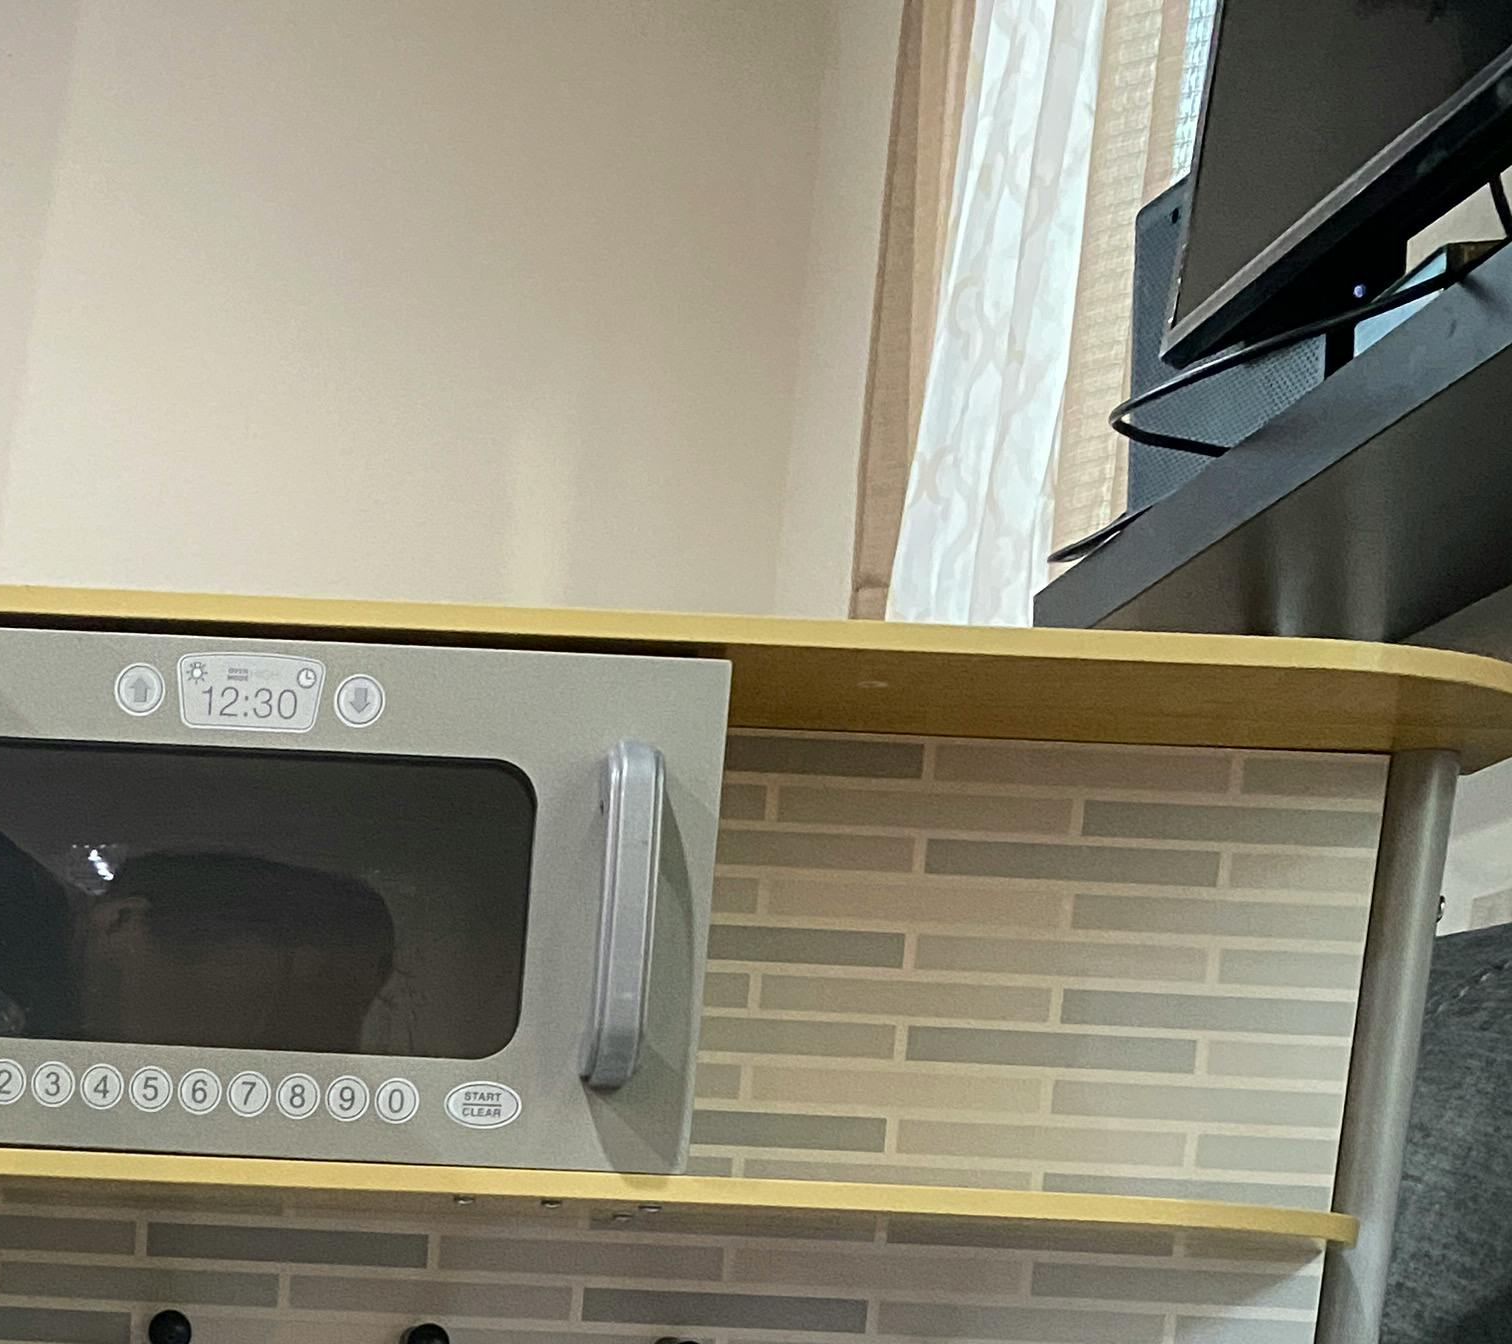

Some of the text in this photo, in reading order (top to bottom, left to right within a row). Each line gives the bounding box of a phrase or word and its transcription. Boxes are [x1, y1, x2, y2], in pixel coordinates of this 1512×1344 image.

[202, 686, 298, 720] 12:30
[44, 1071, 61, 1097] 3
[93, 1074, 109, 1099] 4
[142, 1076, 159, 1101] 5
[191, 1079, 208, 1104] 6
[241, 1081, 257, 1106] 7
[289, 1083, 306, 1109] 8
[338, 1086, 355, 1111] 9
[389, 1088, 405, 1114] 0
[464, 1091, 502, 1102] START
[461, 1107, 502, 1118] CLEAR
